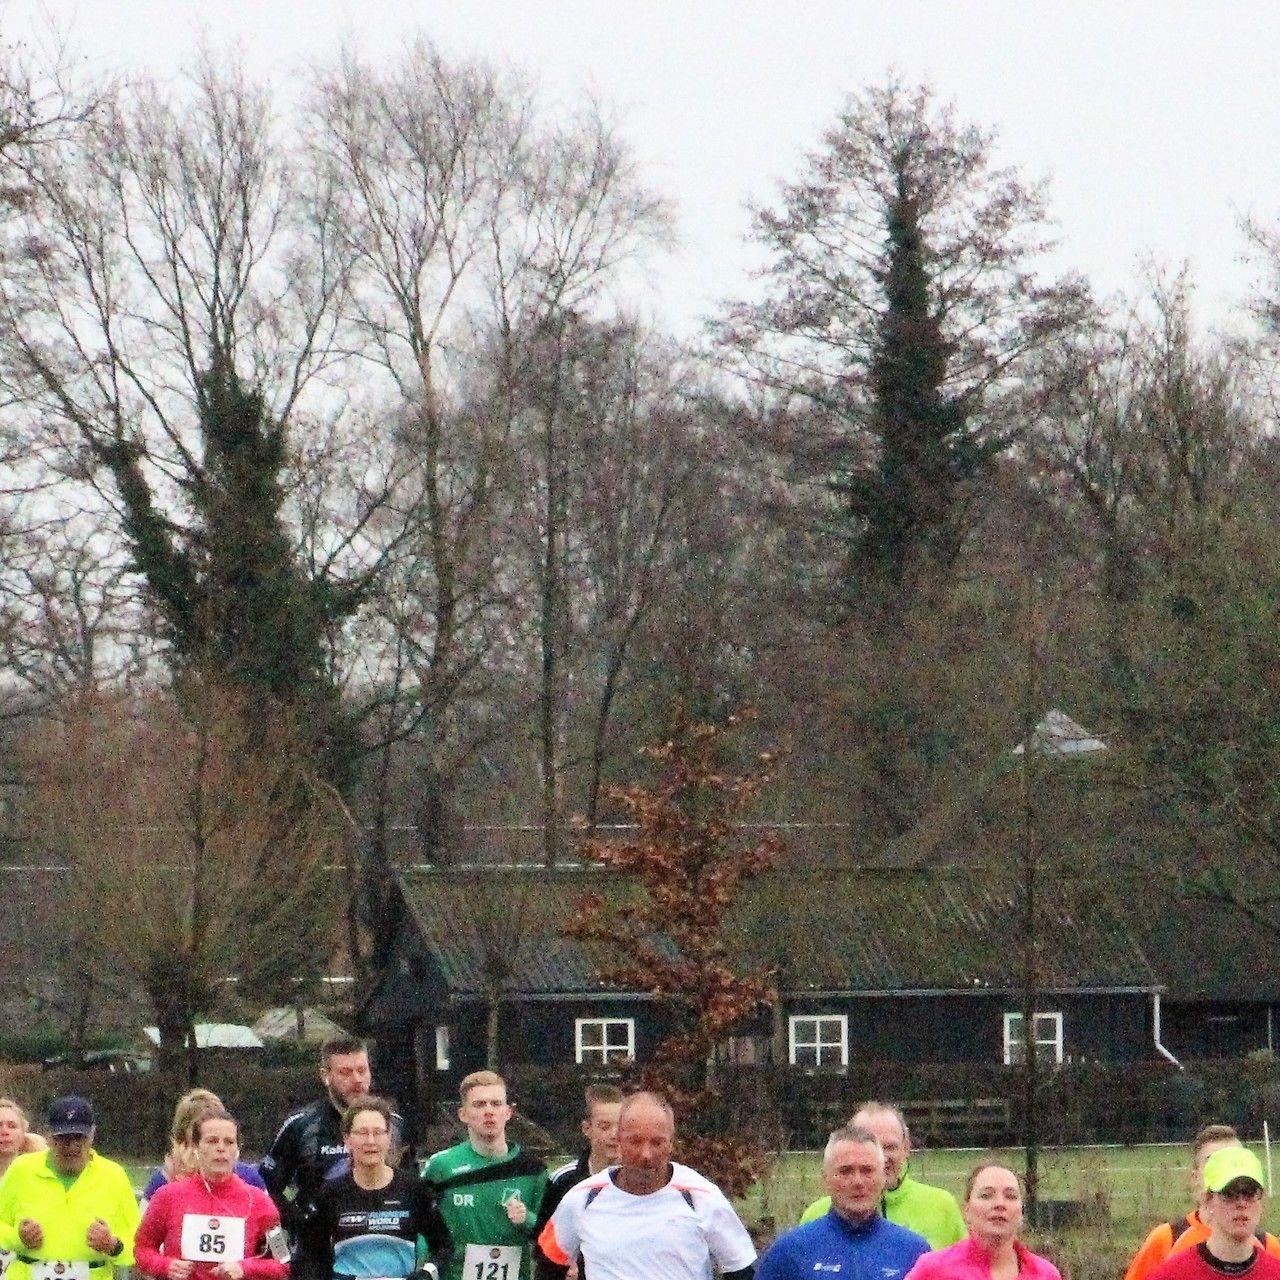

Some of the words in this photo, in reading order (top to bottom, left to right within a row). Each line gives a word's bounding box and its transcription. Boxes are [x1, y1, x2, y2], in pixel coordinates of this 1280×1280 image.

[453, 1194, 475, 1207] DR
[368, 1217, 400, 1225] WORLD
[199, 1233, 226, 1254] 85
[475, 1262, 509, 1280] 121
